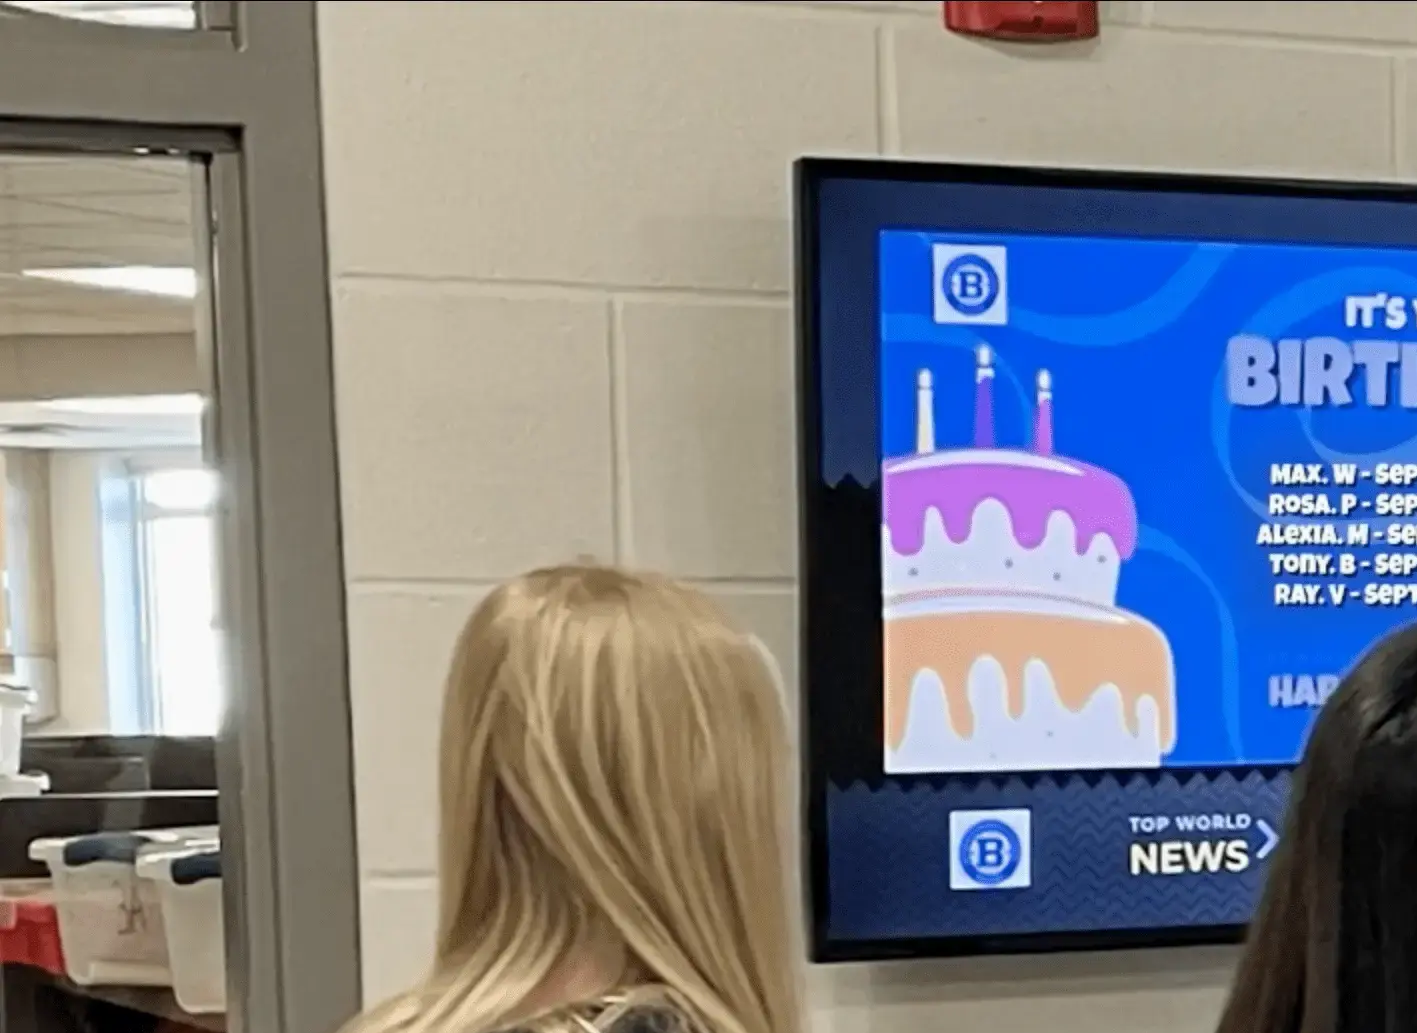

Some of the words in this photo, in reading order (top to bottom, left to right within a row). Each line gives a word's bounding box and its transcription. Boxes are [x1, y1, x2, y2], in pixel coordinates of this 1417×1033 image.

[959, 270, 984, 299] B
[1346, 294, 1406, 329] IT'S
[1270, 463, 1328, 485] MAX.
[1332, 463, 1357, 485] W
[1269, 493, 1337, 515] ROSA.
[1341, 493, 1357, 515] P
[1347, 523, 1369, 545] M
[1339, 553, 1356, 574] B
[1274, 583, 1325, 604] RAY.
[1329, 584, 1345, 605] V
[1269, 674, 1342, 708] HAP
[1129, 816, 1170, 833] TOP
[1175, 813, 1251, 831] WORLD
[975, 837, 1004, 868] B
[1131, 839, 1249, 875] NEWS
